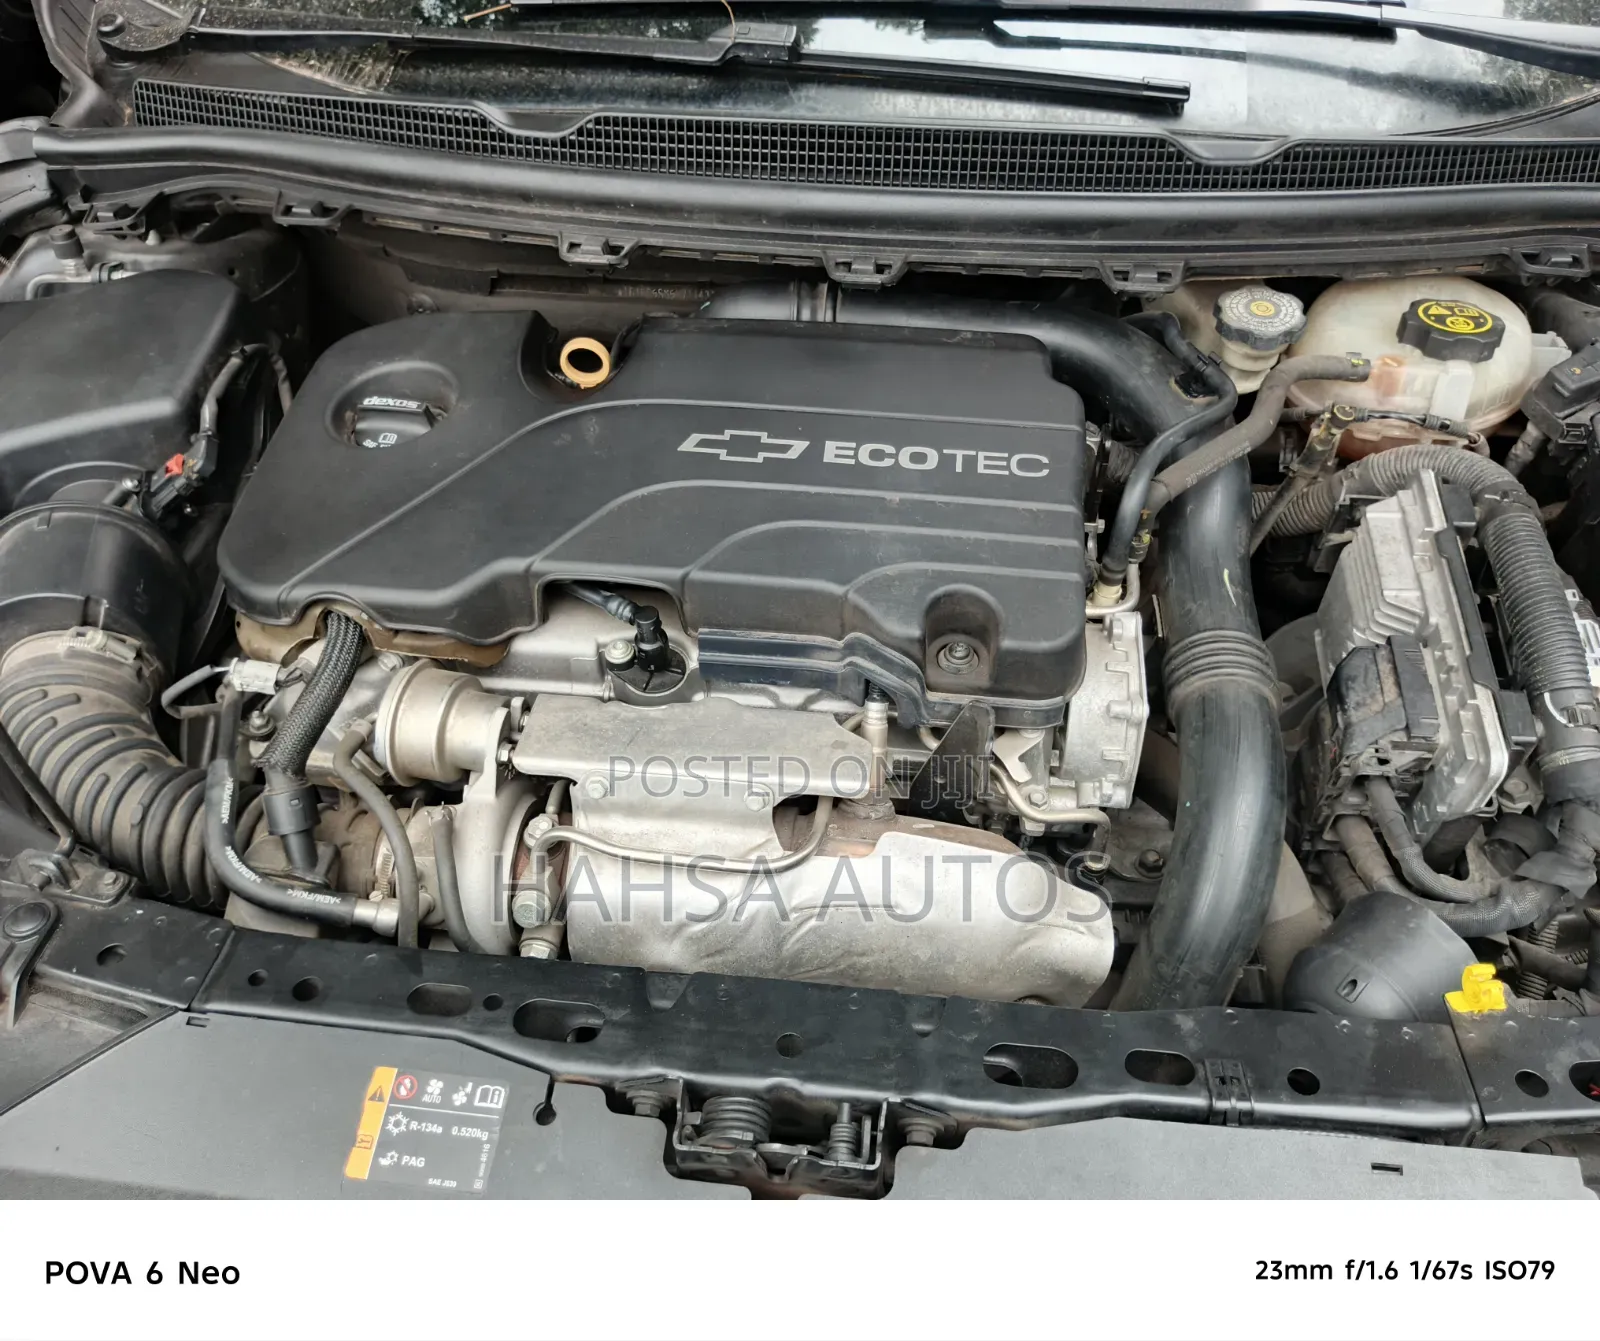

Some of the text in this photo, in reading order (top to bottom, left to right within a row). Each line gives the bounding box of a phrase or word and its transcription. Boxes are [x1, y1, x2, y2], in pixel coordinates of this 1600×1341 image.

[363, 396, 419, 409] dexos
[822, 440, 1050, 477] ECOTEC
[421, 1094, 442, 1104] AUTO
[409, 1121, 489, 1141] R-134a 0.520kg
[401, 1156, 426, 1168] PAG
